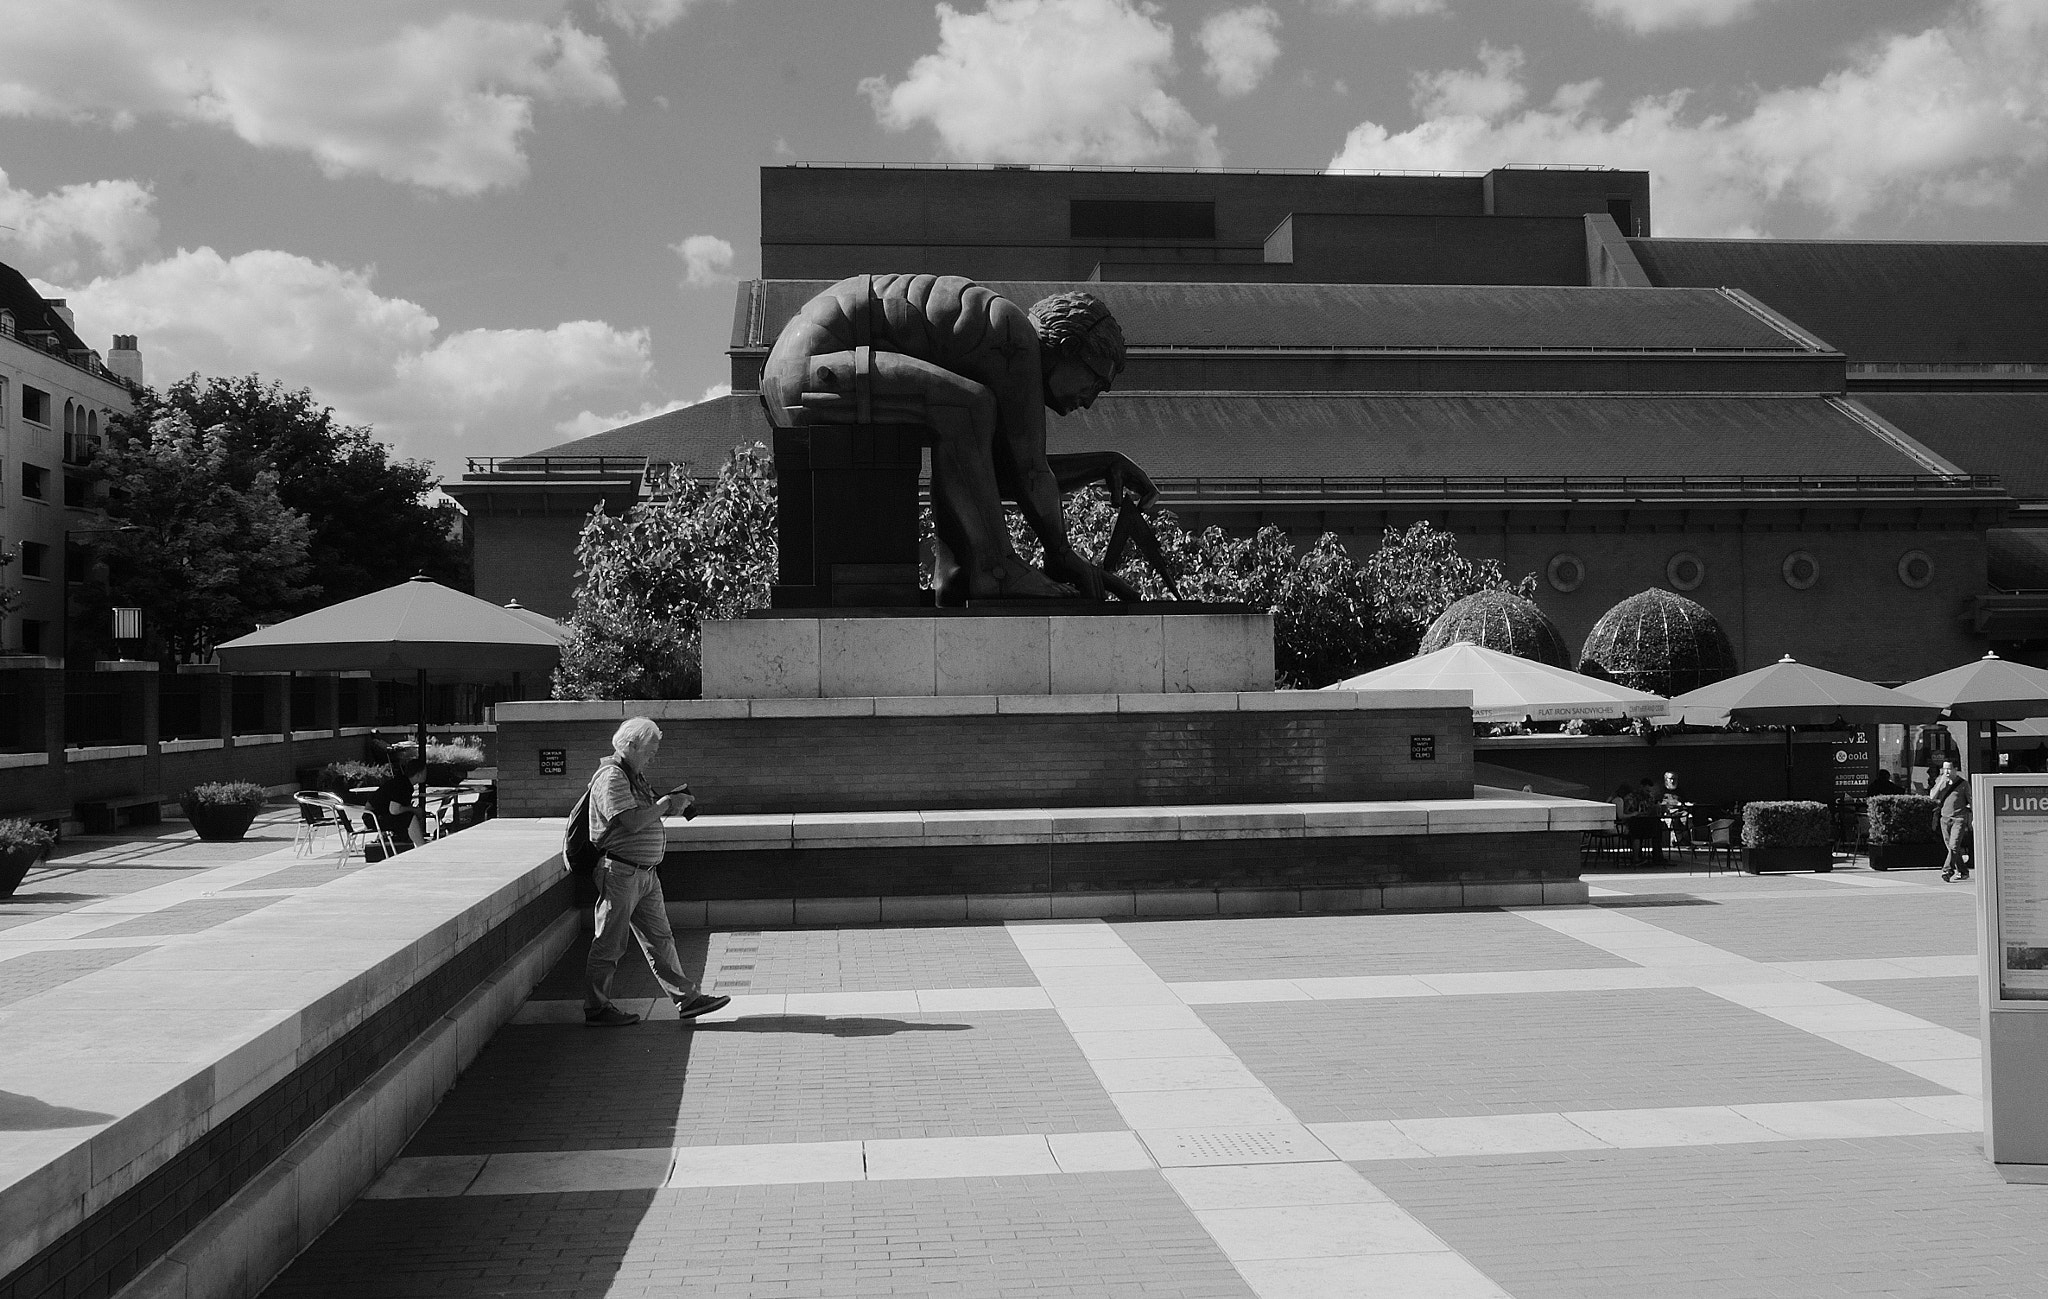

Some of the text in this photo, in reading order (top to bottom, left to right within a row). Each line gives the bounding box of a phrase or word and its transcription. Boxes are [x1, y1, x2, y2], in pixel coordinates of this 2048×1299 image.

[1538, 708, 1553, 716] FLAT
[1572, 706, 1614, 715] SANDWICHES
[1848, 751, 1868, 760] cold
[2001, 793, 2048, 811] June
